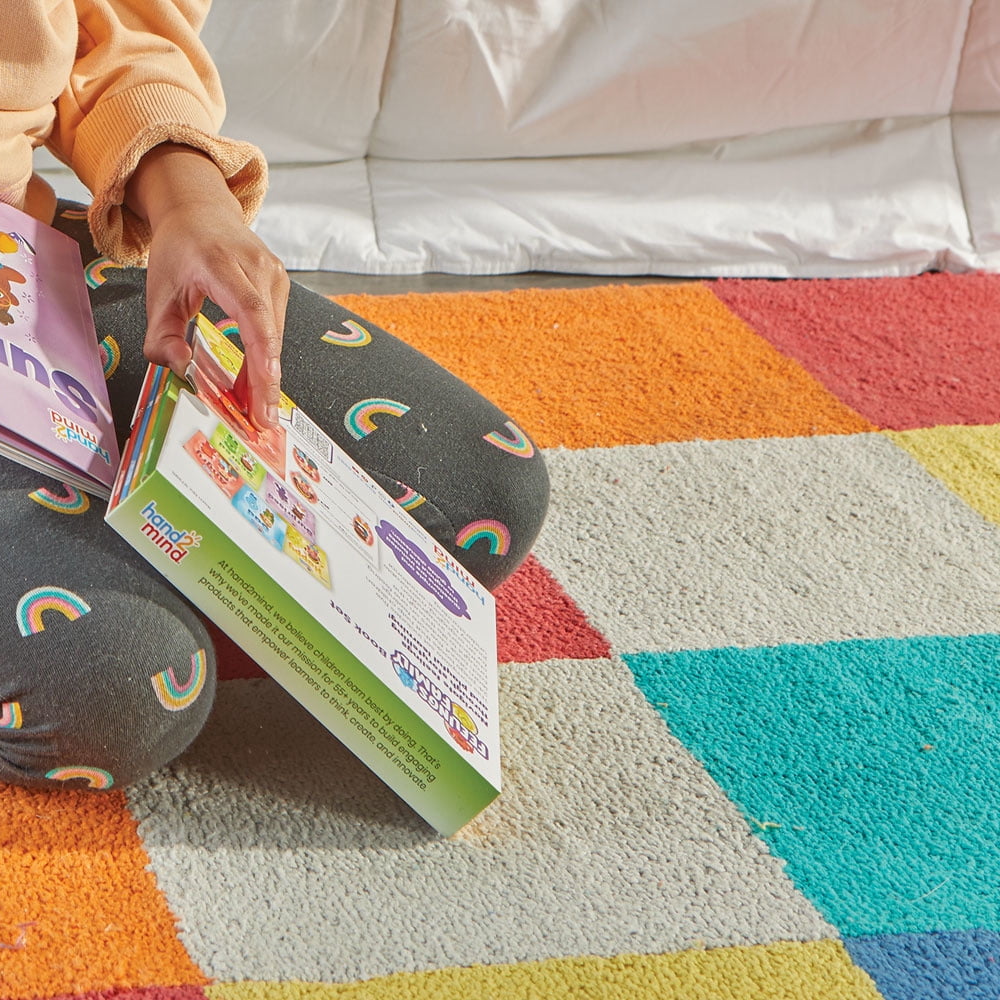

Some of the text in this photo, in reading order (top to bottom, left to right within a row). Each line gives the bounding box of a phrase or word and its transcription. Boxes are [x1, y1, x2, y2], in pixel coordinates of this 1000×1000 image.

[51, 411, 97, 444] mind
[141, 521, 187, 562] mind
[217, 560, 440, 769] At hand2mind, we believe children learn best by doing. That's
[330, 599, 386, 657] Book Set
[197, 576, 428, 793] products that empower learners to think, create, and innovate.
[209, 568, 435, 782] why we've made it our mission for 55+ years to build engaging
[391, 644, 451, 713] FAMILY
[416, 680, 486, 759] FEELINGS
